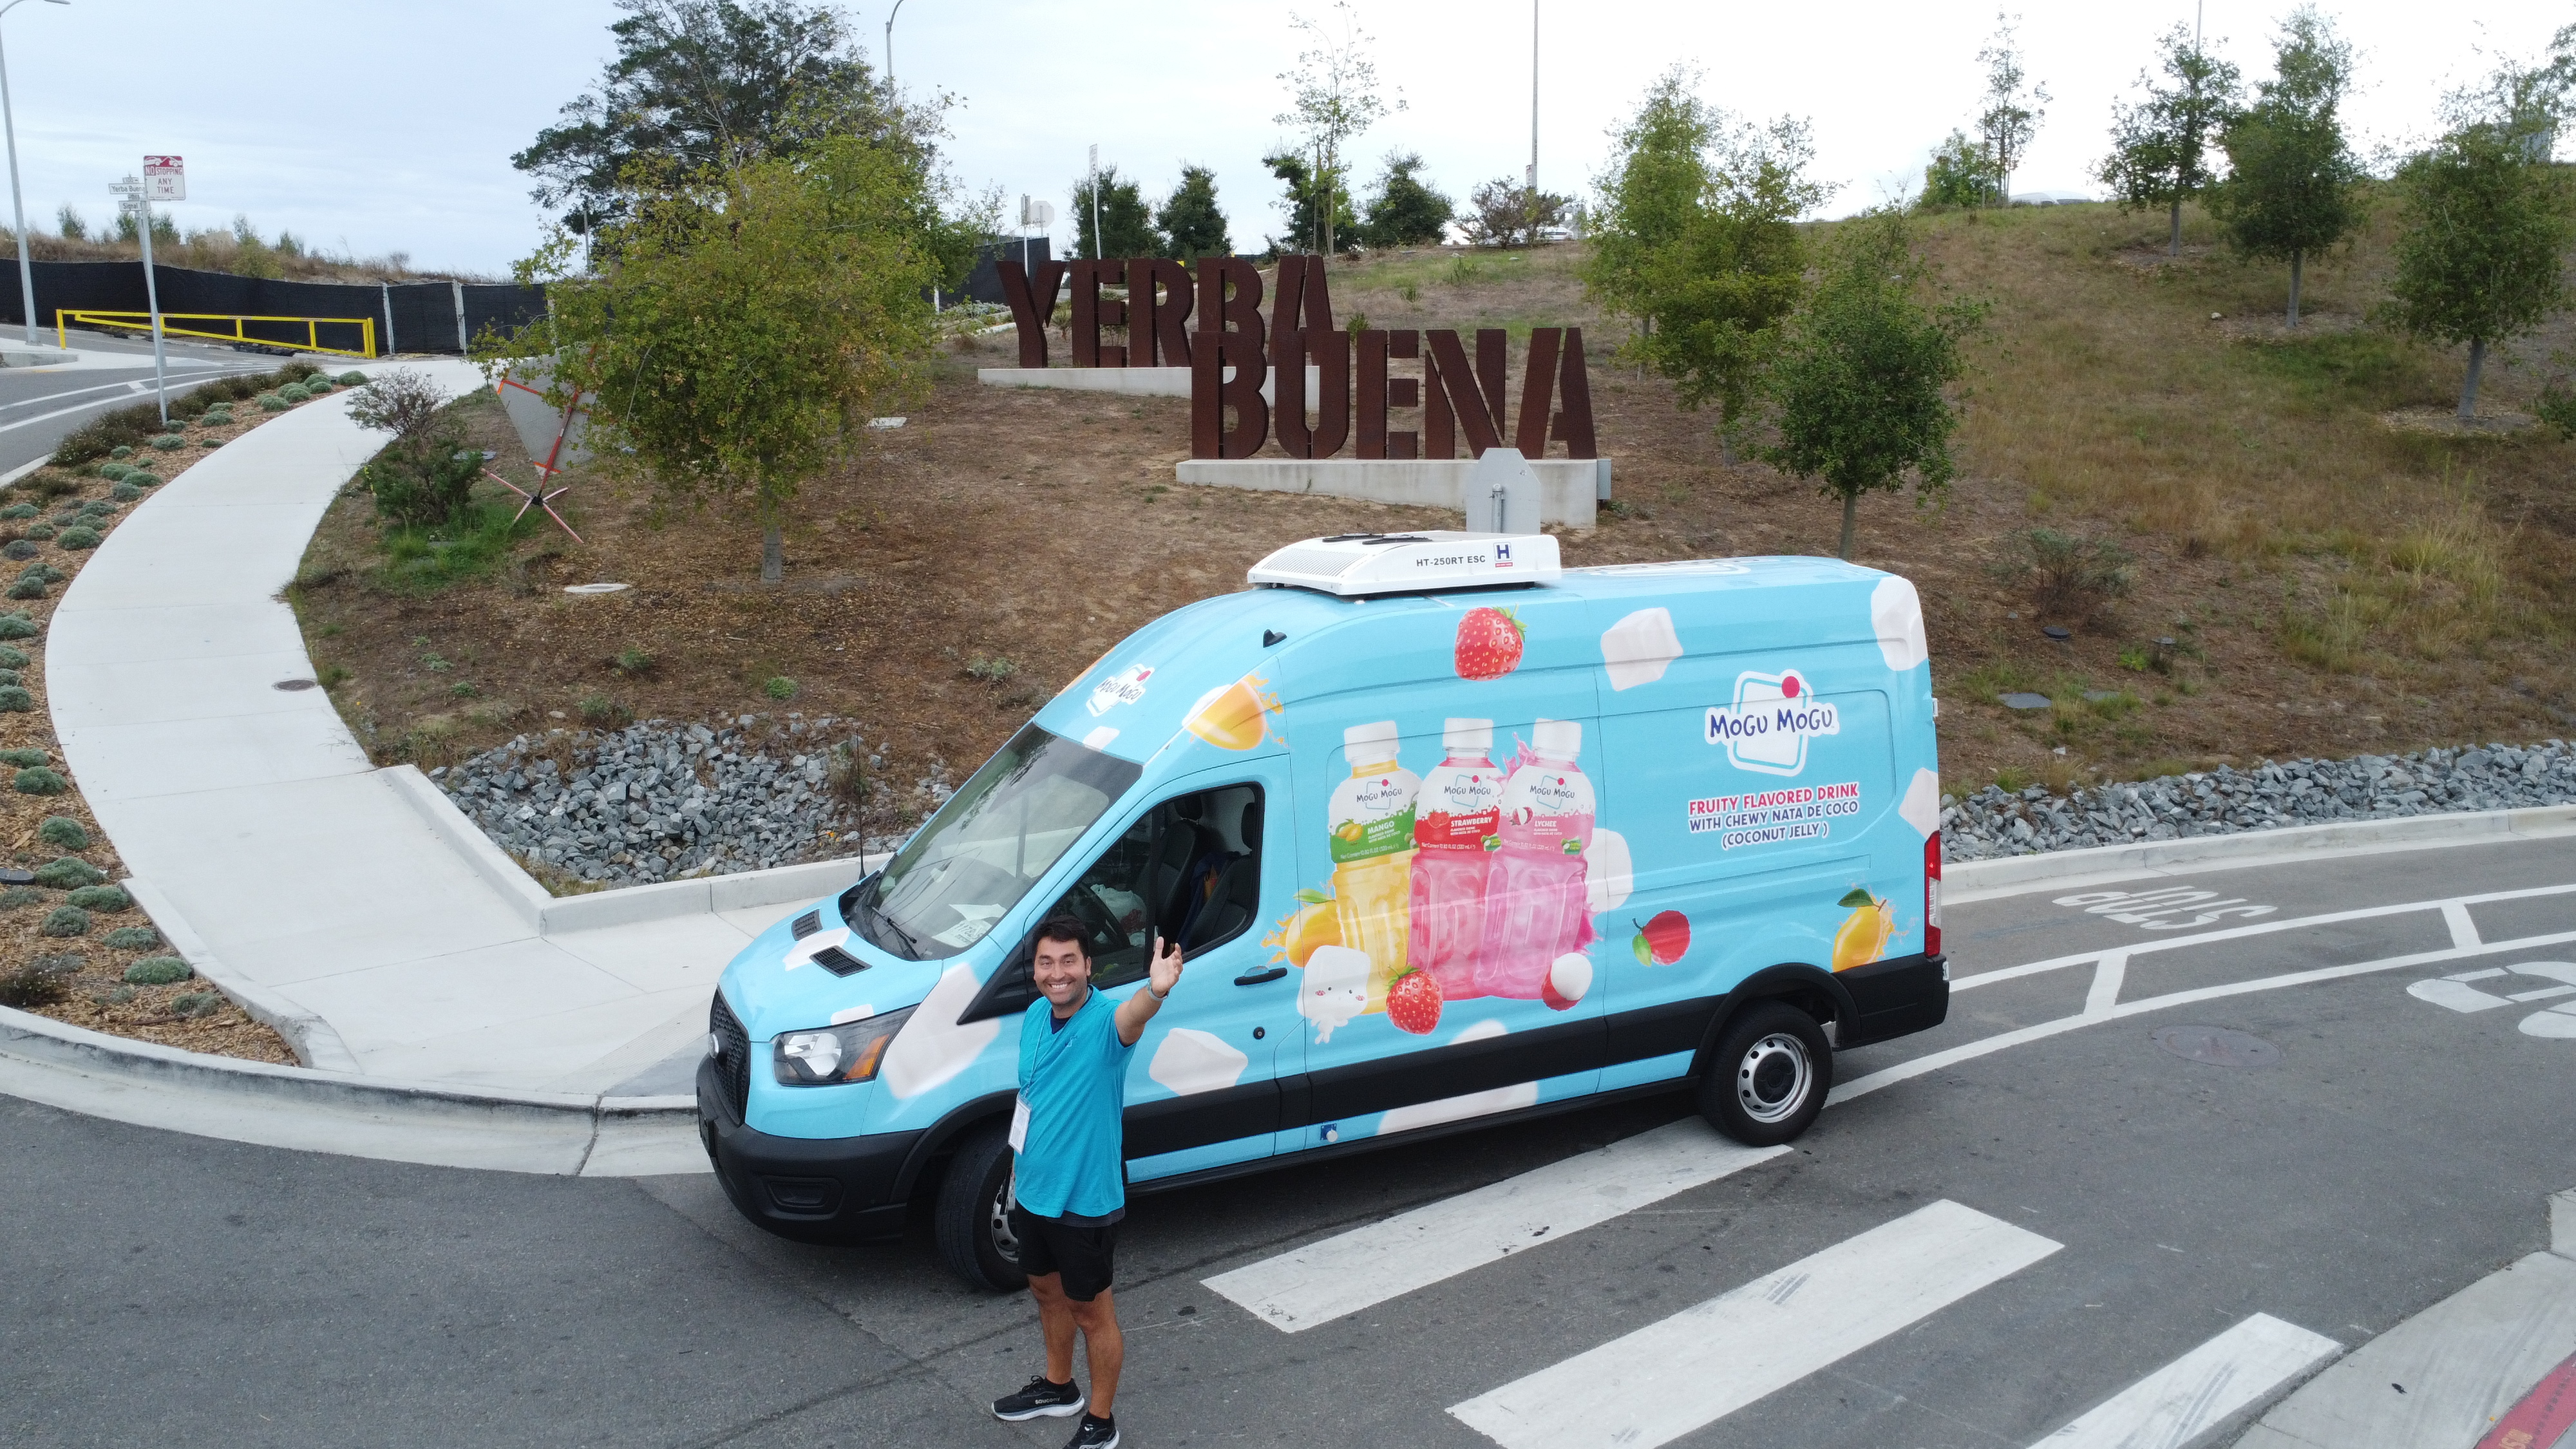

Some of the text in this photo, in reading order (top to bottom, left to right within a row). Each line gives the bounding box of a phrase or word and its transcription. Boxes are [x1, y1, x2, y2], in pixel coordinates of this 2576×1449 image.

[145, 166, 182, 176] NO STOPPING
[996, 254, 1333, 369] YERBA
[1191, 327, 1598, 460] BUENA
[1416, 555, 1486, 567] HT-250RT ESC
[1497, 544, 1510, 559] H
[1689, 783, 1859, 815] FRUITY FLAVORED DRINK
[1450, 817, 1493, 828] STRAWBERRY
[1689, 801, 1859, 831] WITH CHEWY NATA DE COCO
[1367, 820, 1395, 835] MANGO
[1722, 828, 1786, 848] (COCONUT
[2051, 885, 2278, 930] STOP
